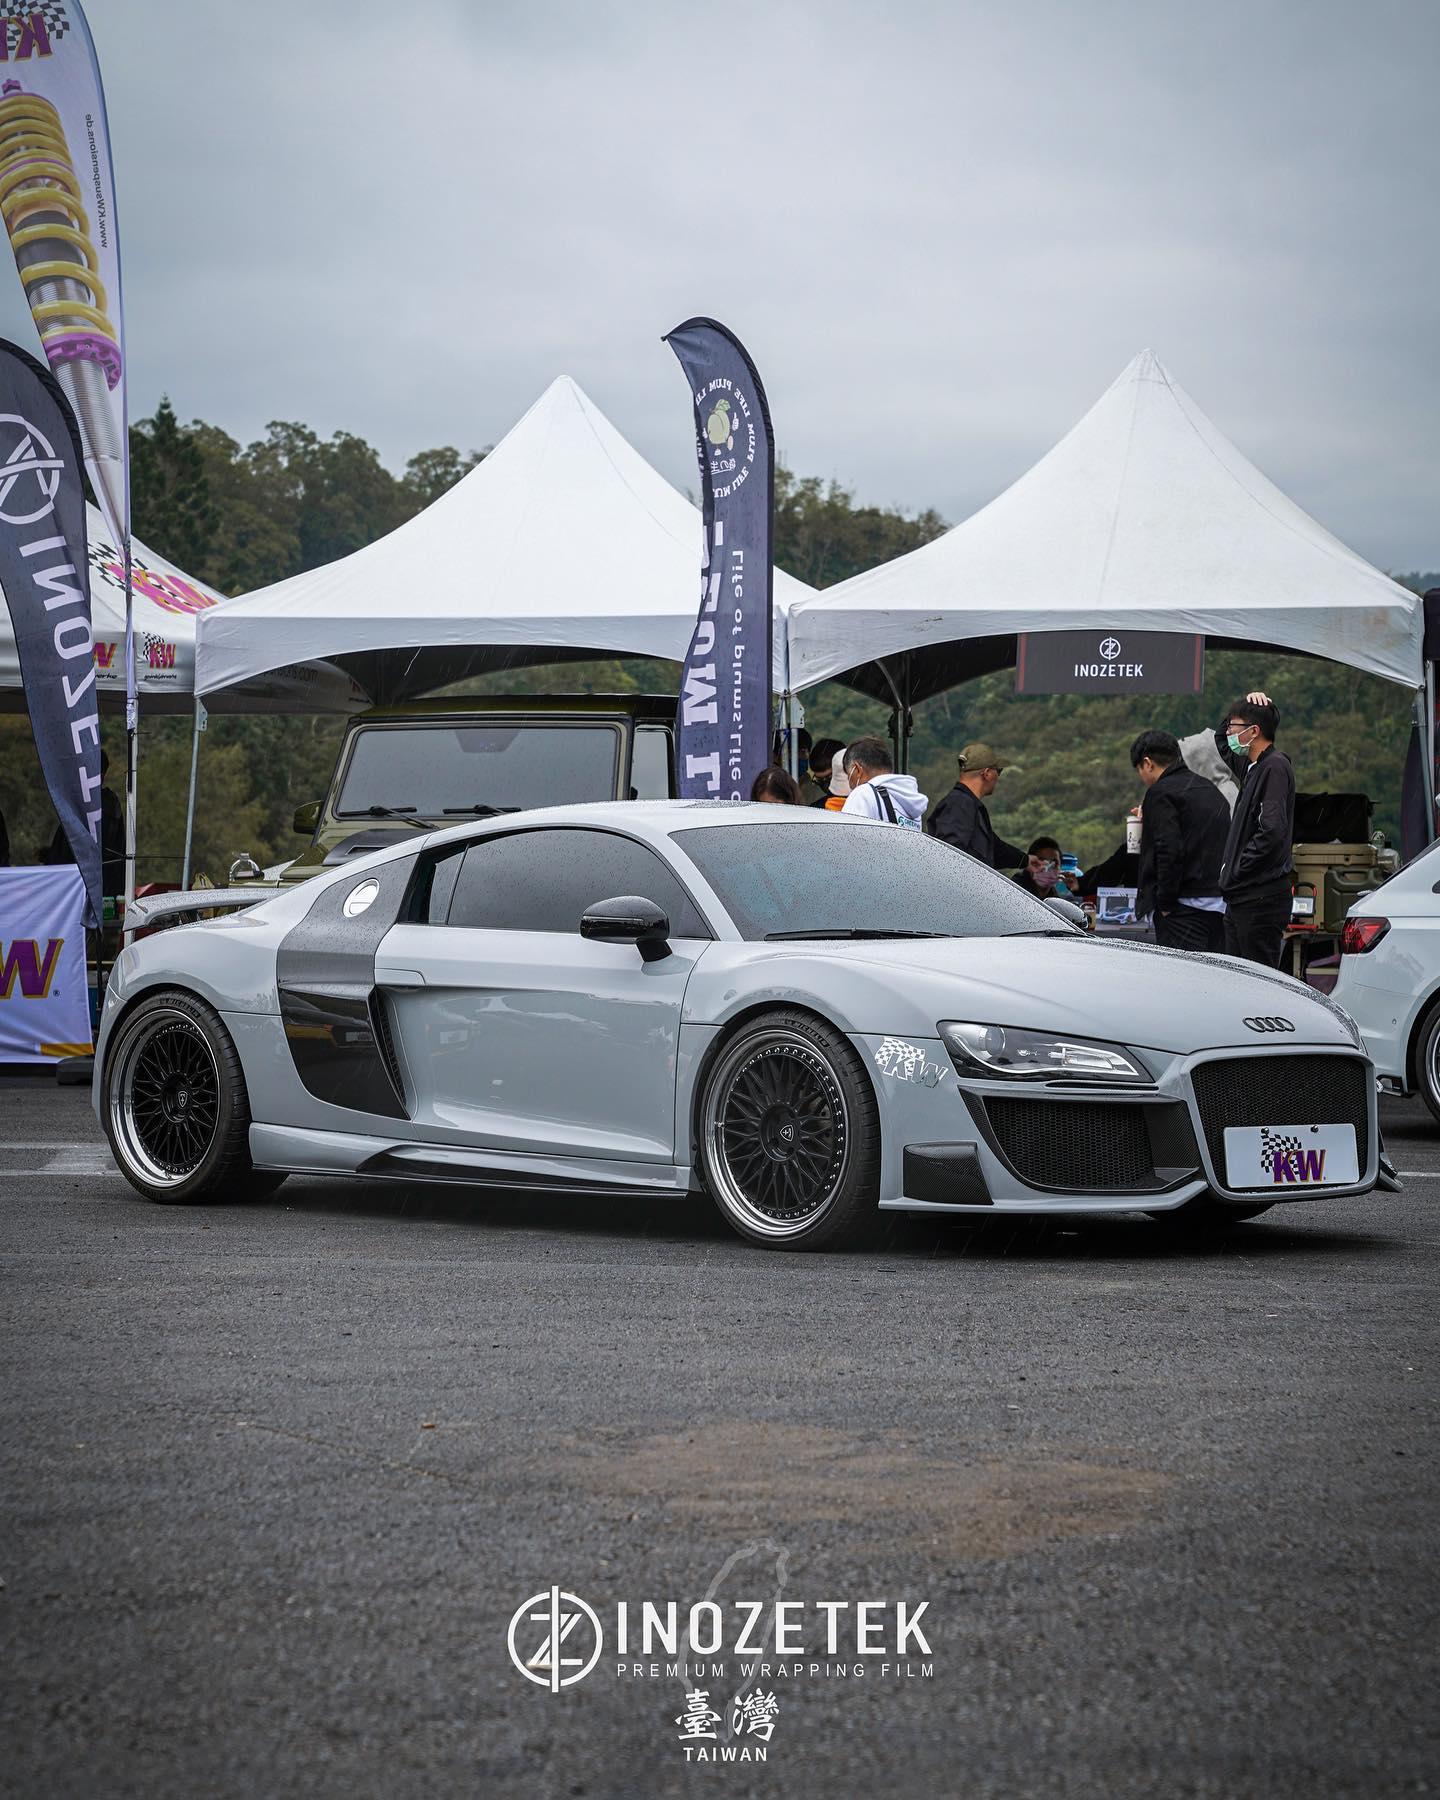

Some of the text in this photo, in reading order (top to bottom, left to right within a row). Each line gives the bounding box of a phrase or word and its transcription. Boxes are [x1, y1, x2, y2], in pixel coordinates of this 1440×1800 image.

[93, 642, 117, 668] W
[149, 643, 176, 669] KW
[1074, 664, 1144, 677] INOZETEK
[883, 1052, 949, 1088] KW
[1273, 1149, 1326, 1183] KW
